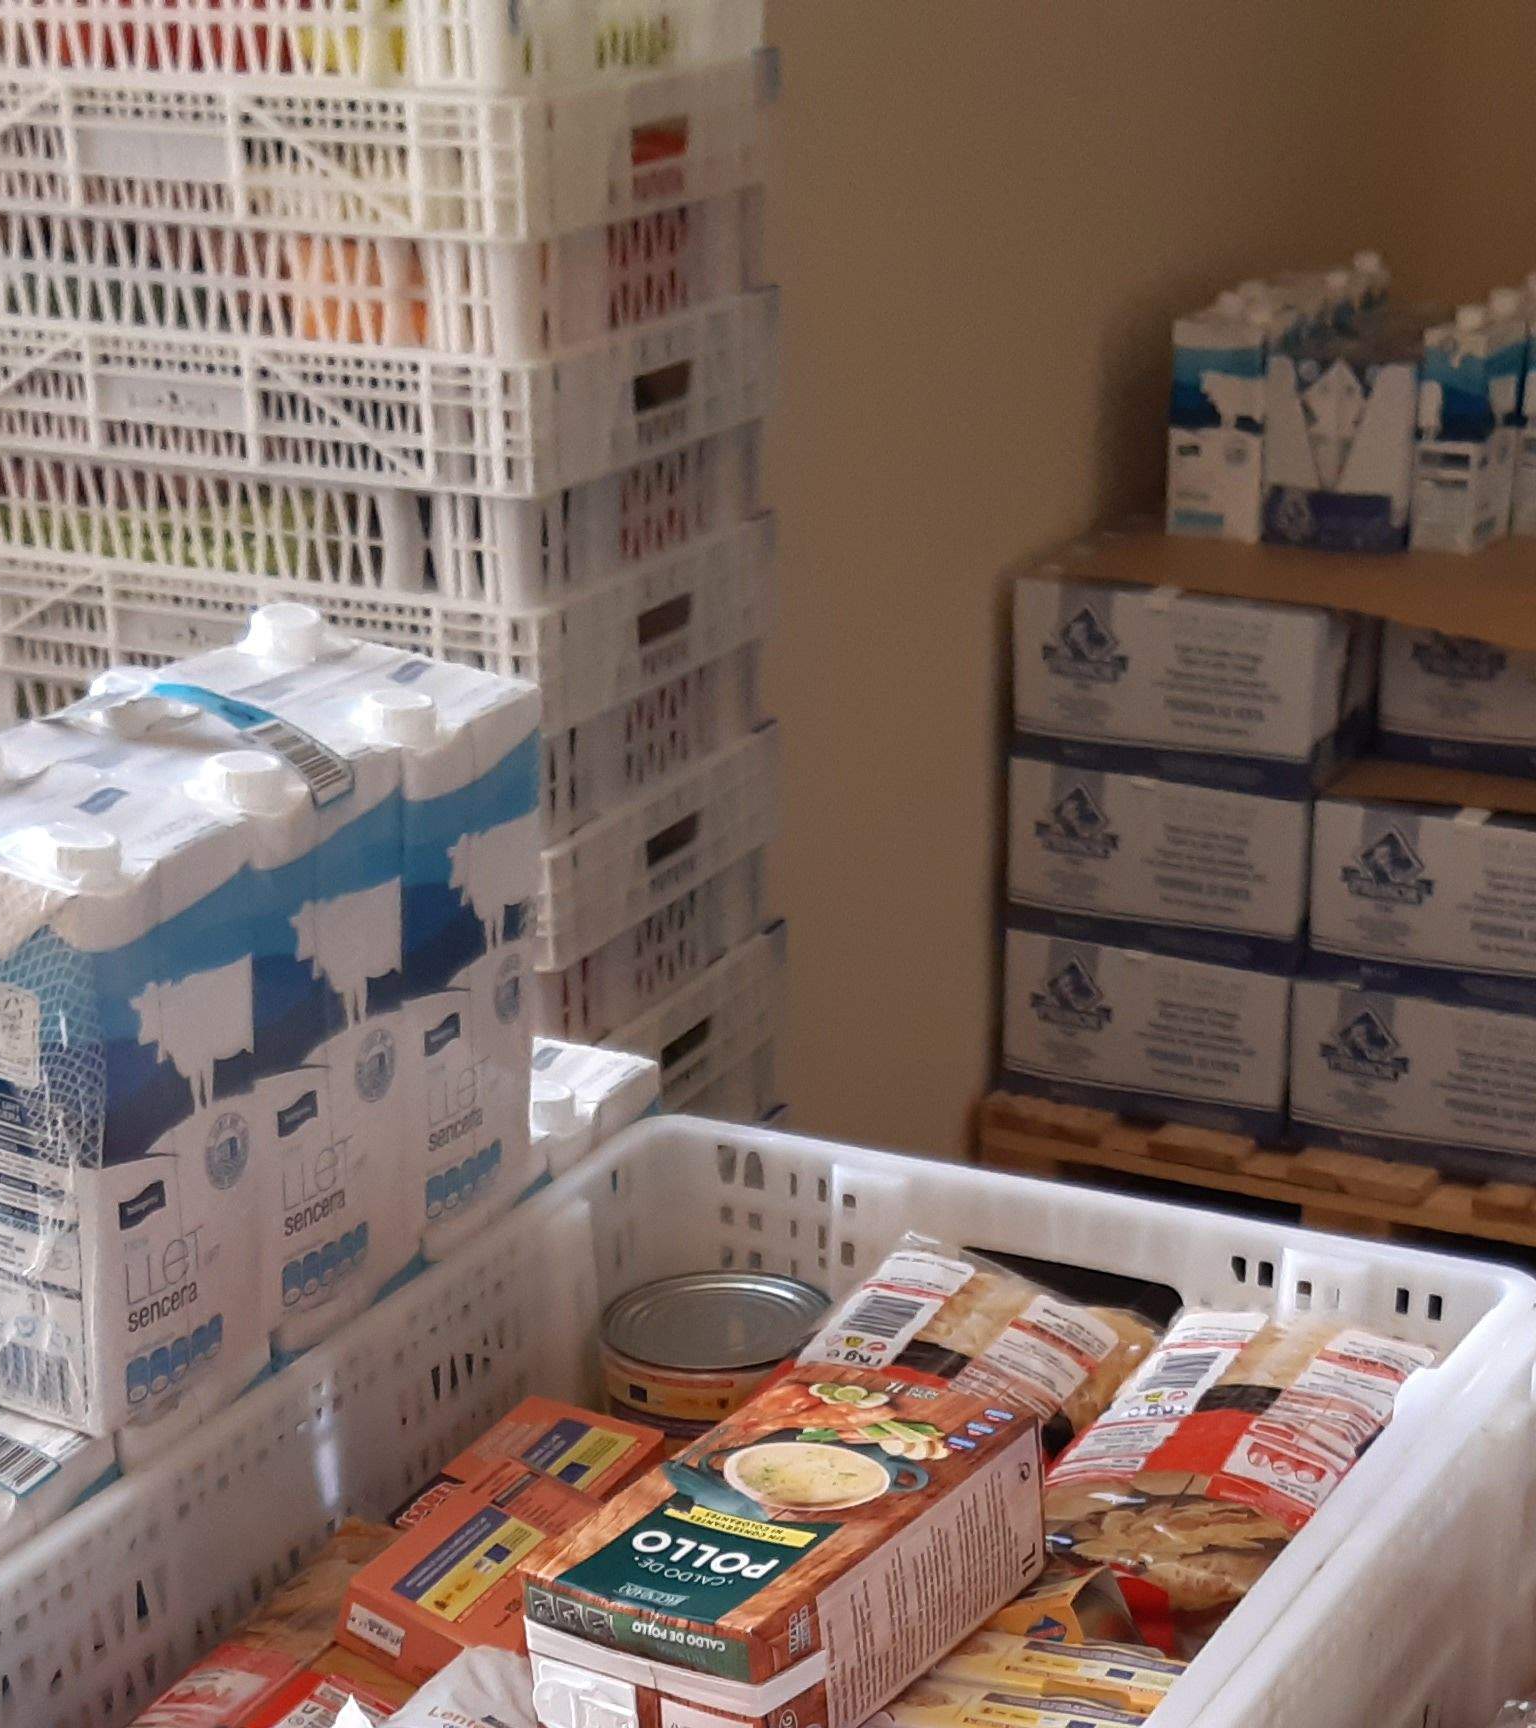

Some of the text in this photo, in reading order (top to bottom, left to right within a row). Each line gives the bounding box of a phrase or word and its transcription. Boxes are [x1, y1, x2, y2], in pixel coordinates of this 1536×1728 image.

[284, 1189, 346, 1237] sencera
[127, 1281, 199, 1333] sencera
[631, 1529, 780, 1580] POLLO
[638, 1557, 727, 1587] CALDO DE
[631, 1620, 727, 1653] CALDO DE POLLO
